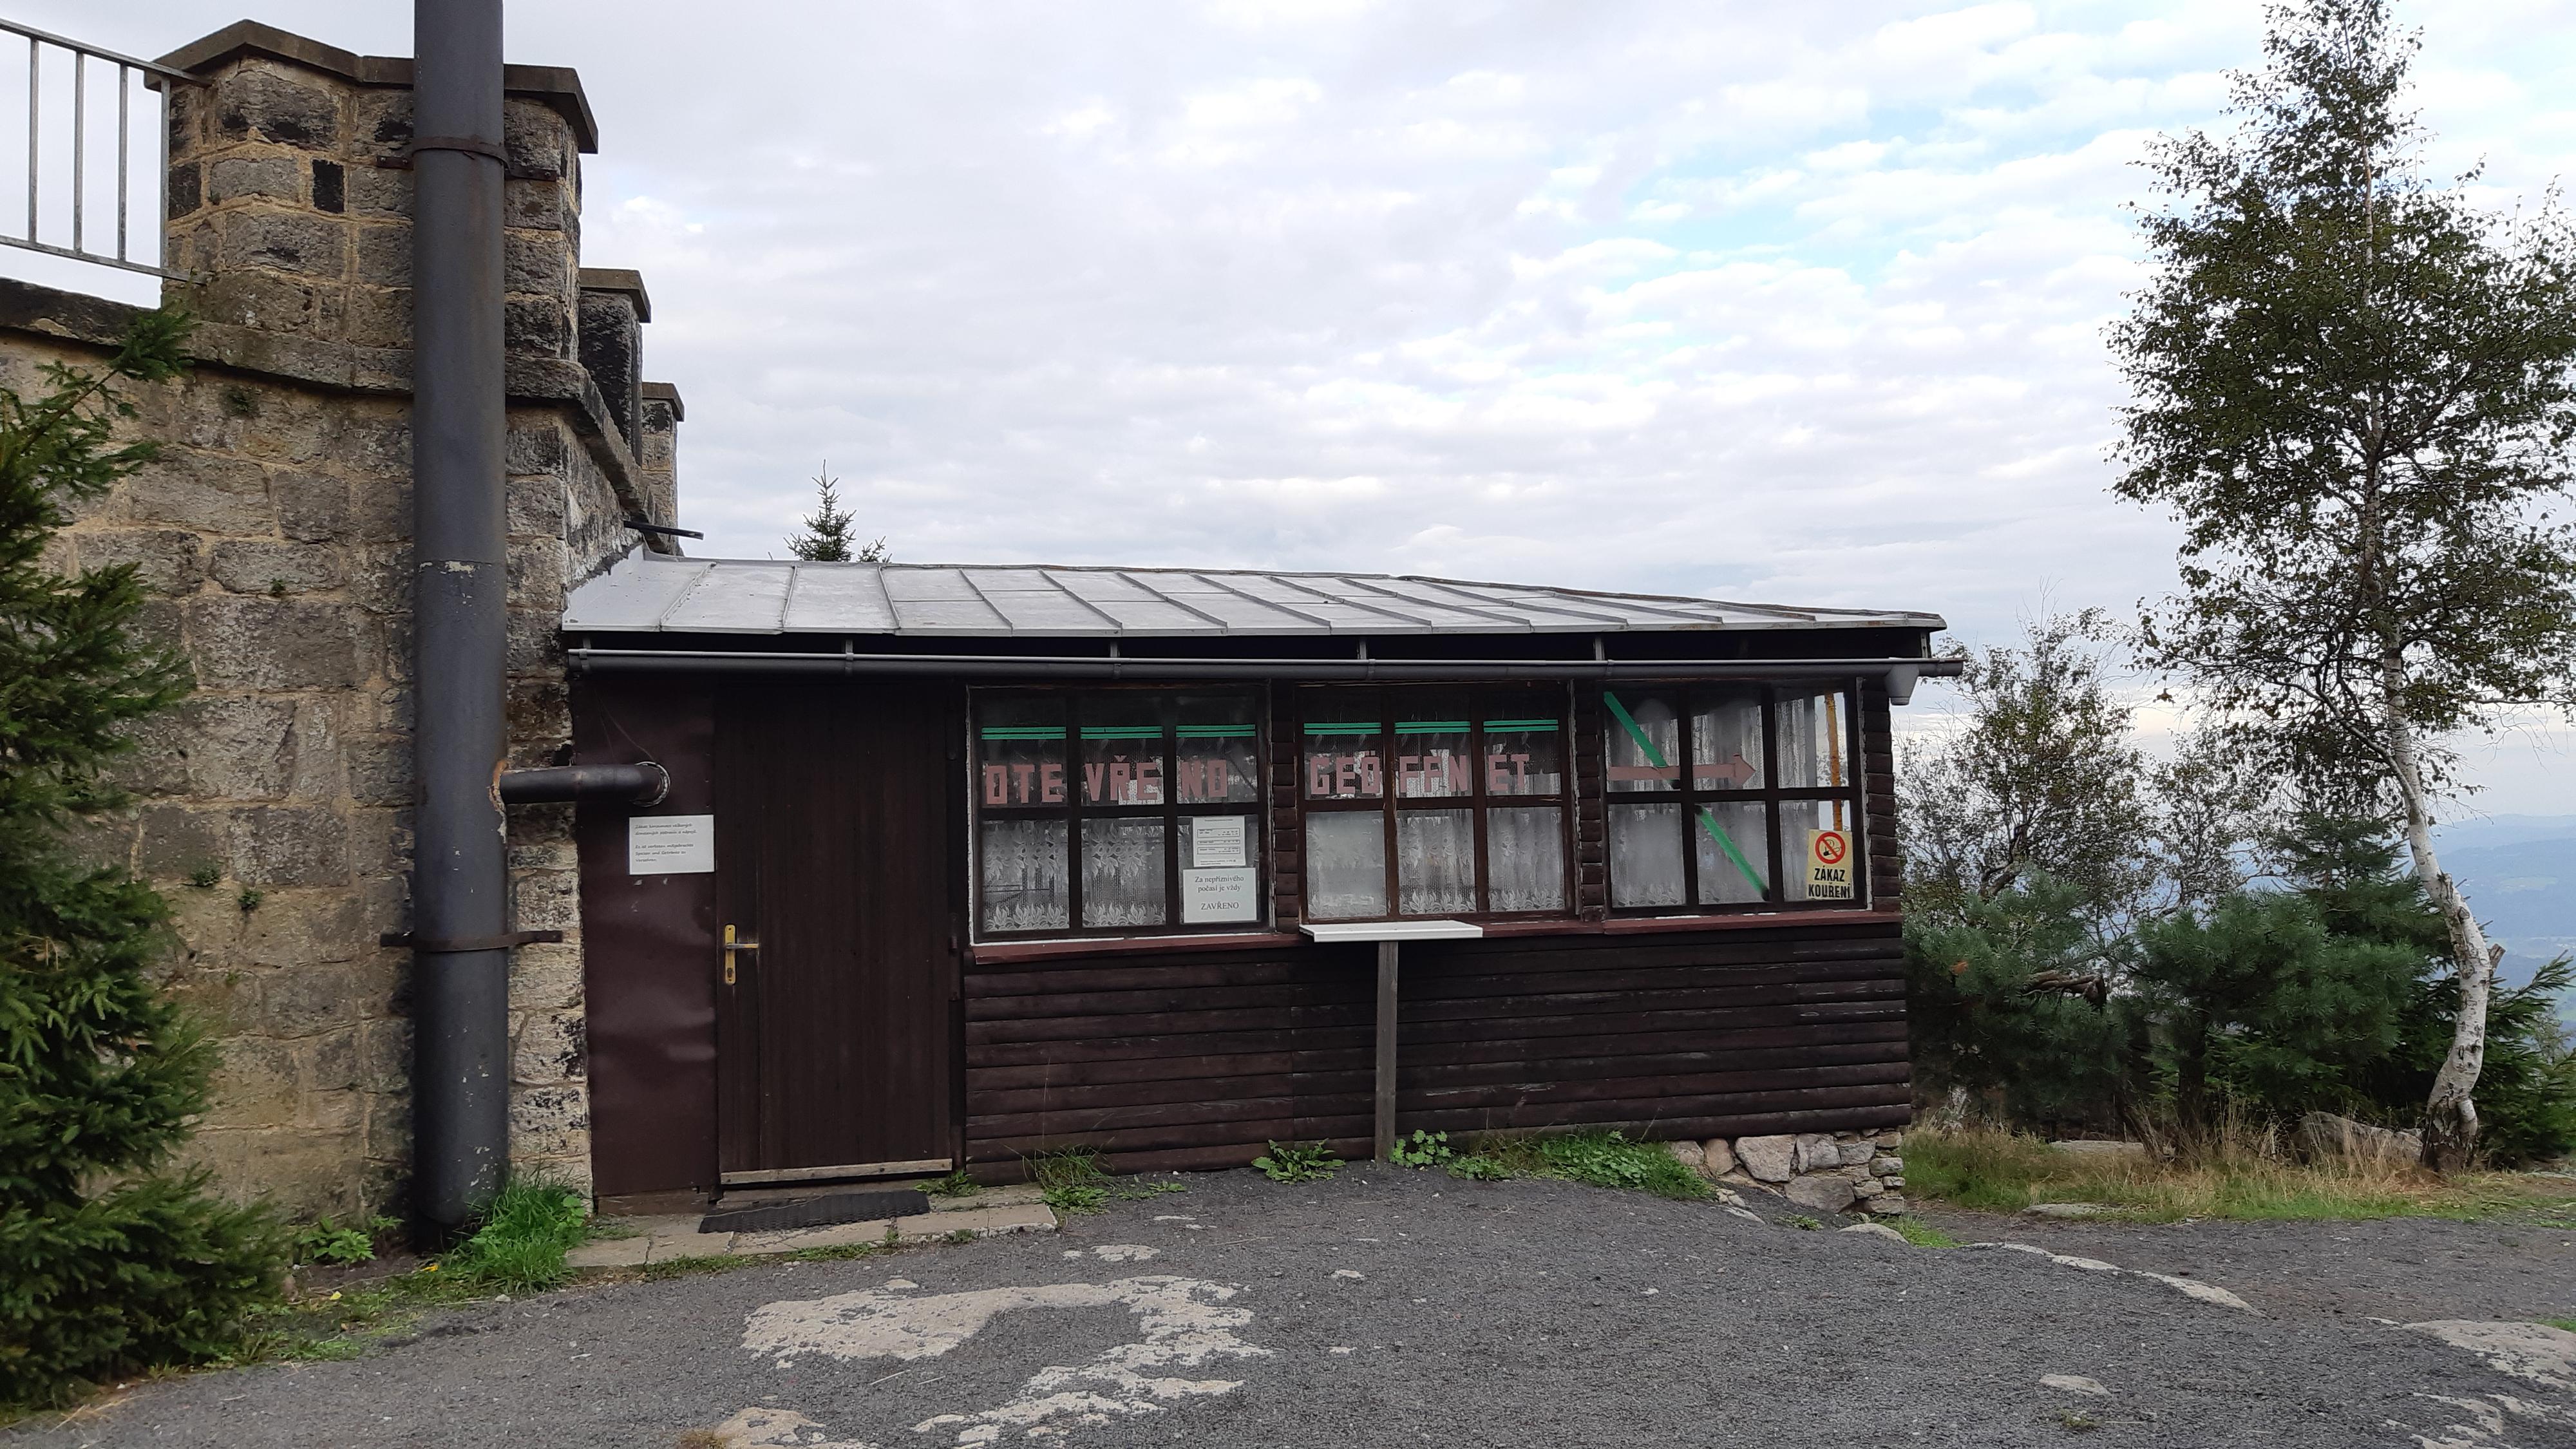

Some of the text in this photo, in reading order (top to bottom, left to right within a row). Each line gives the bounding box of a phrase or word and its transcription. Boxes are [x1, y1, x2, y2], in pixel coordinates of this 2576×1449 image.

[1814, 866, 1846, 882] ZÁKAZ
[1204, 875, 1244, 884] nepříznivého
[1198, 884, 1218, 893] počasí
[1227, 884, 1241, 892] vždy
[1808, 882, 1851, 898] KOUŘENÍ
[1201, 902, 1239, 910] ZAVŘENO
